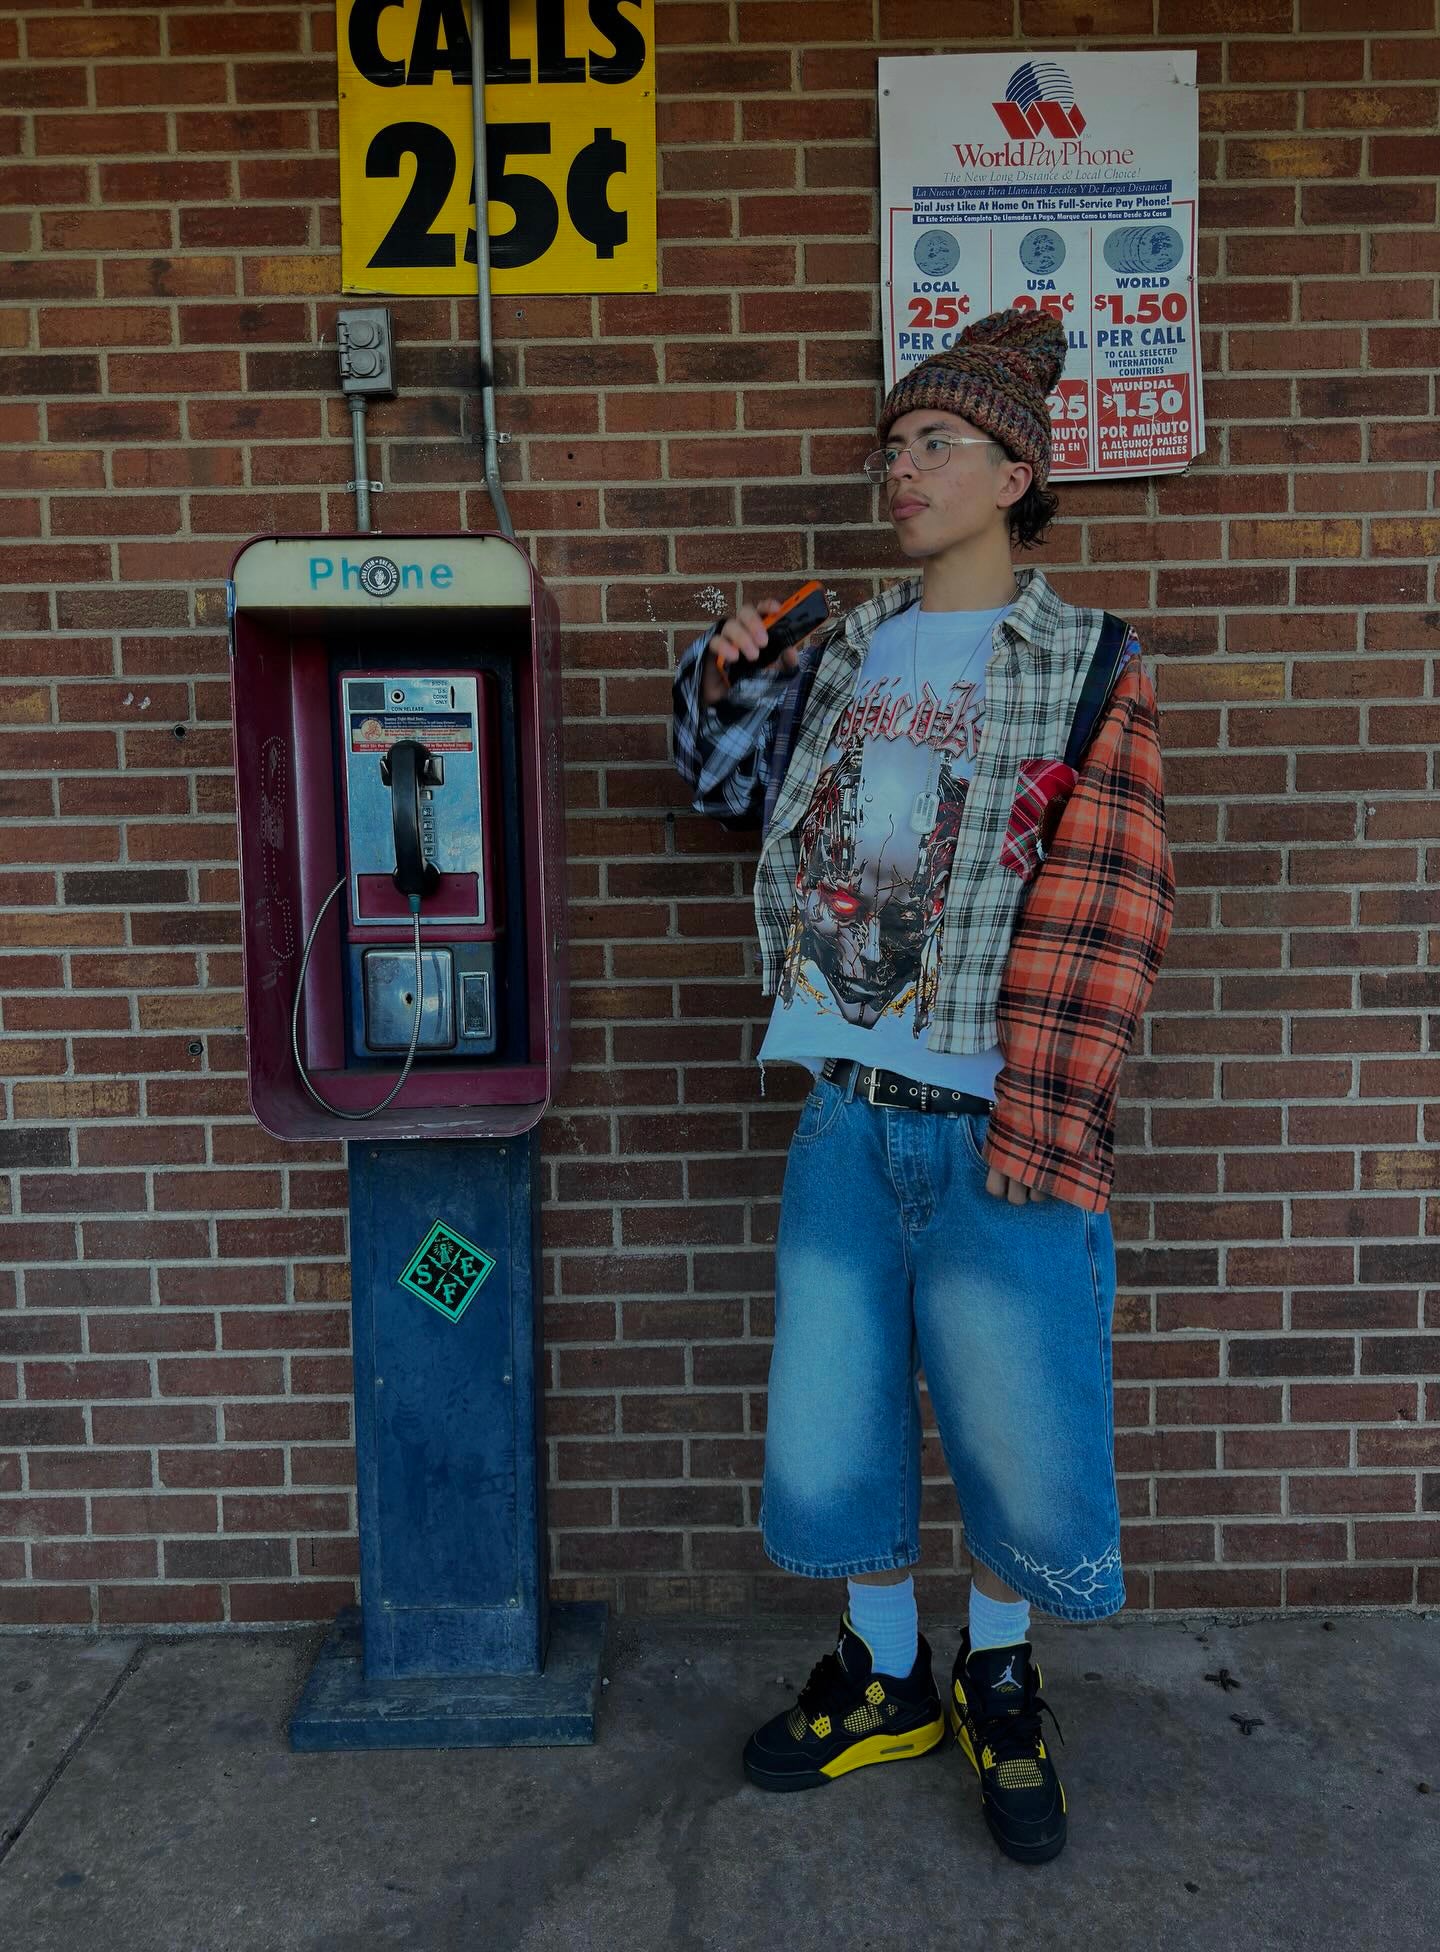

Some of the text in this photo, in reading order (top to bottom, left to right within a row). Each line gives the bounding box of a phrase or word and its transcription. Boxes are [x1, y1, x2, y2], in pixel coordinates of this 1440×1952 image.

[348, 0, 646, 87] CALLS
[943, 168, 1141, 184] The New Long Distance & Local Choice!
[365, 121, 628, 270] 25¢
[916, 188, 926, 197] La
[929, 187, 955, 196] Nueva
[987, 186, 1006, 196] Para
[1008, 185, 1047, 195] Llamadas
[1049, 185, 1078, 194] Locales
[1080, 184, 1087, 193] Y
[1088, 184, 1100, 193] De
[1102, 184, 1126, 195] Larga
[1128, 182, 1168, 192] Distancia
[914, 195, 1170, 212] Dial Just Like At Home On This Full-Service Pay Phone!
[963, 214, 992, 223] Completo
[1002, 213, 1032, 221] Llamadas
[1057, 213, 1080, 221] Marque
[913, 281, 960, 293] LOCAL
[1026, 279, 1056, 291] USA
[1115, 277, 1170, 289] WORLD
[908, 294, 970, 329] 25¢
[1094, 292, 1188, 325] $1.50
[898, 332, 934, 350] PER
[1069, 331, 1088, 349] LL
[1097, 327, 1186, 347] PER CALL
[900, 353, 931, 361] ANYWH
[1104, 347, 1178, 359] TO CALL SELECTED
[1109, 356, 1174, 368] INTERNATIONAL
[1119, 366, 1164, 377] COUNTRIES
[1112, 378, 1175, 392] MUNDIAL
[1102, 389, 1183, 417] $1.50
[1051, 427, 1088, 441] NUTO
[1099, 420, 1189, 439] POR MINUTO
[1068, 442, 1081, 451] EN
[1101, 435, 1188, 450] A ALGUNOS PAISES
[1103, 446, 1187, 460] INTERNACIONALES
[308, 557, 454, 591] Phne
